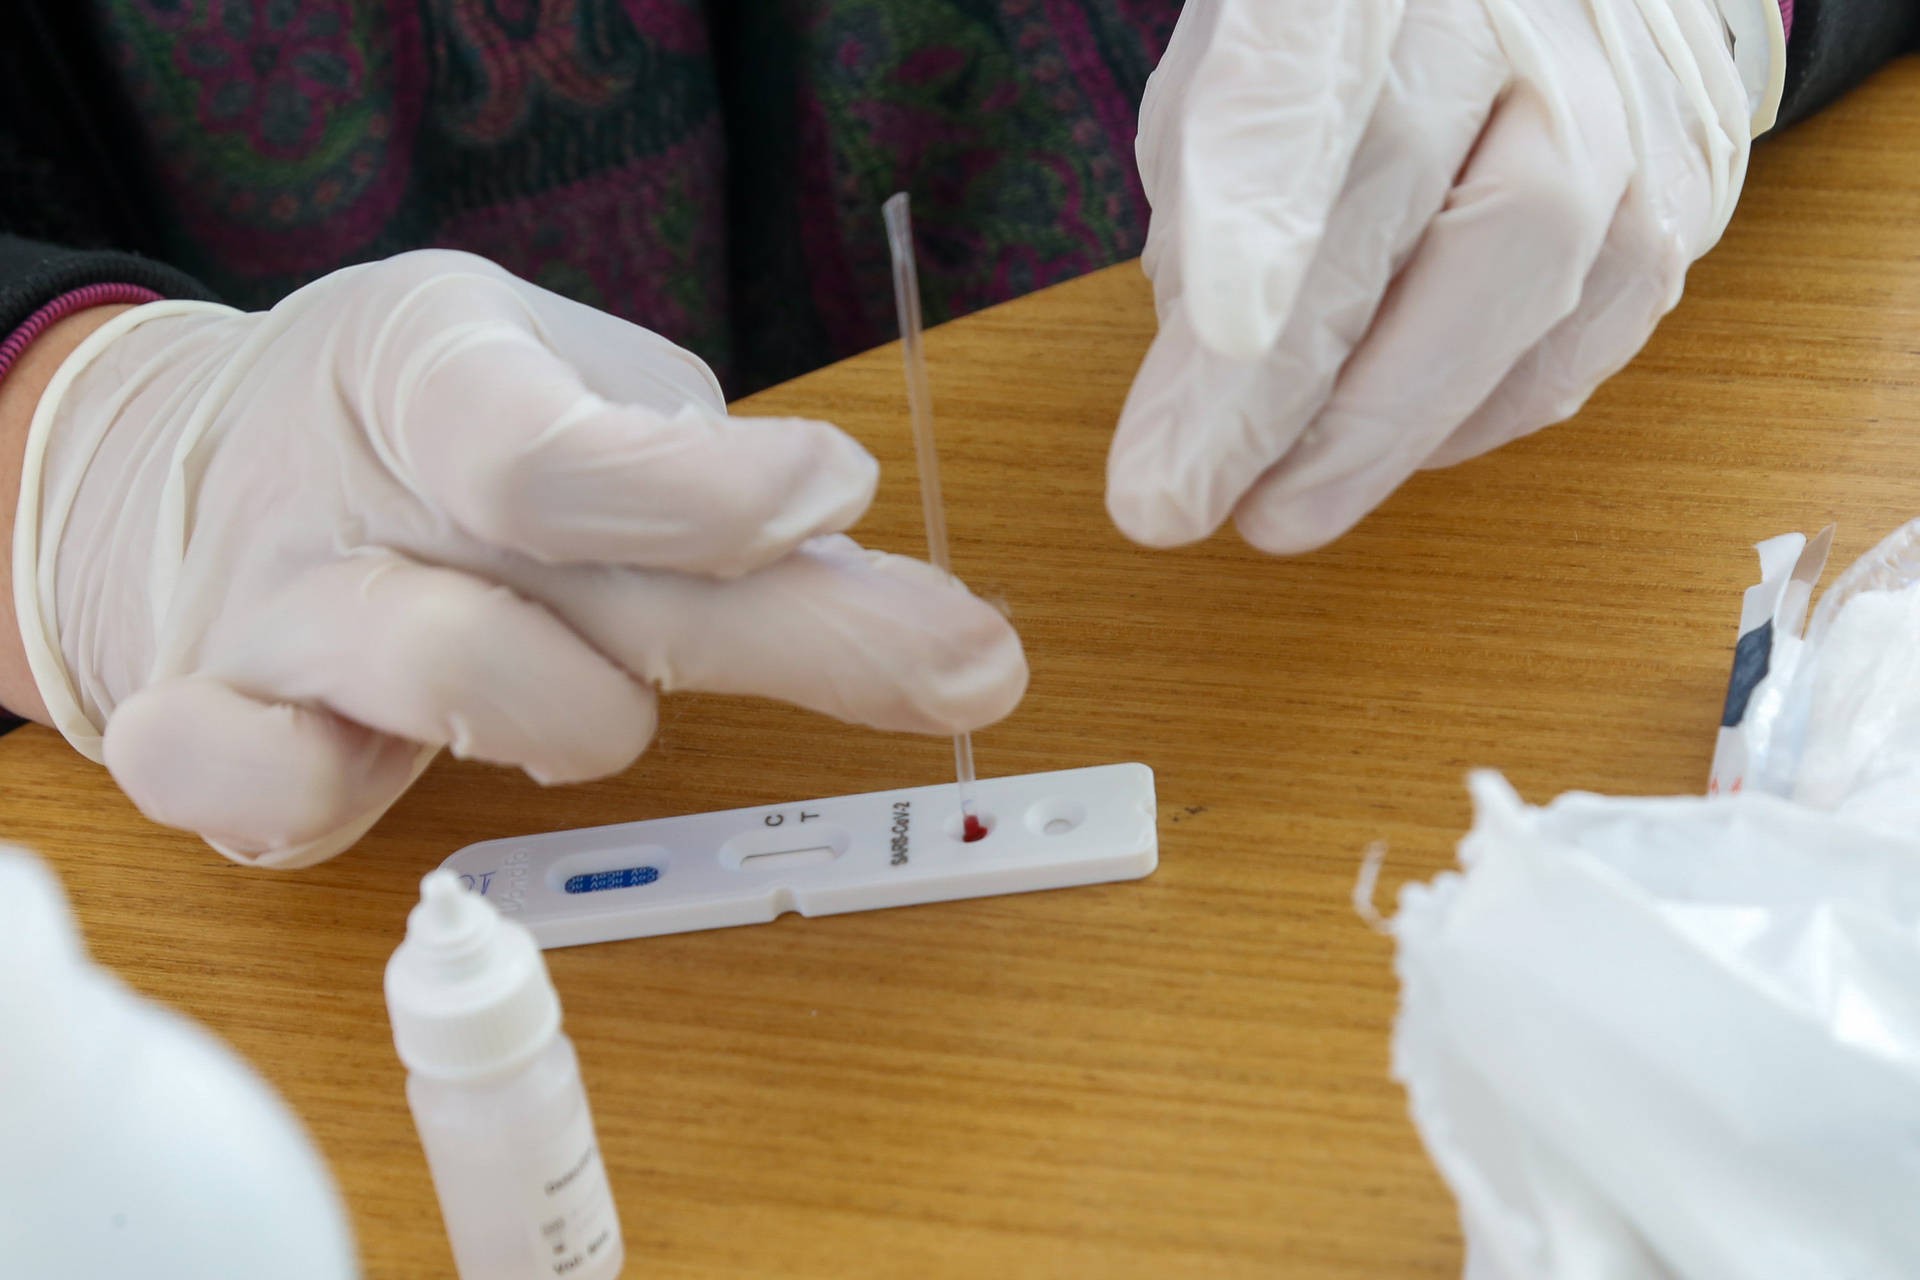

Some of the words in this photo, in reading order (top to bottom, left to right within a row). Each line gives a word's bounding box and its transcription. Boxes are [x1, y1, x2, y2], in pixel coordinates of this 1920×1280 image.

[765, 814, 784, 827] C
[800, 811, 820, 823] T
[890, 801, 911, 866] SARS-CoV-2
